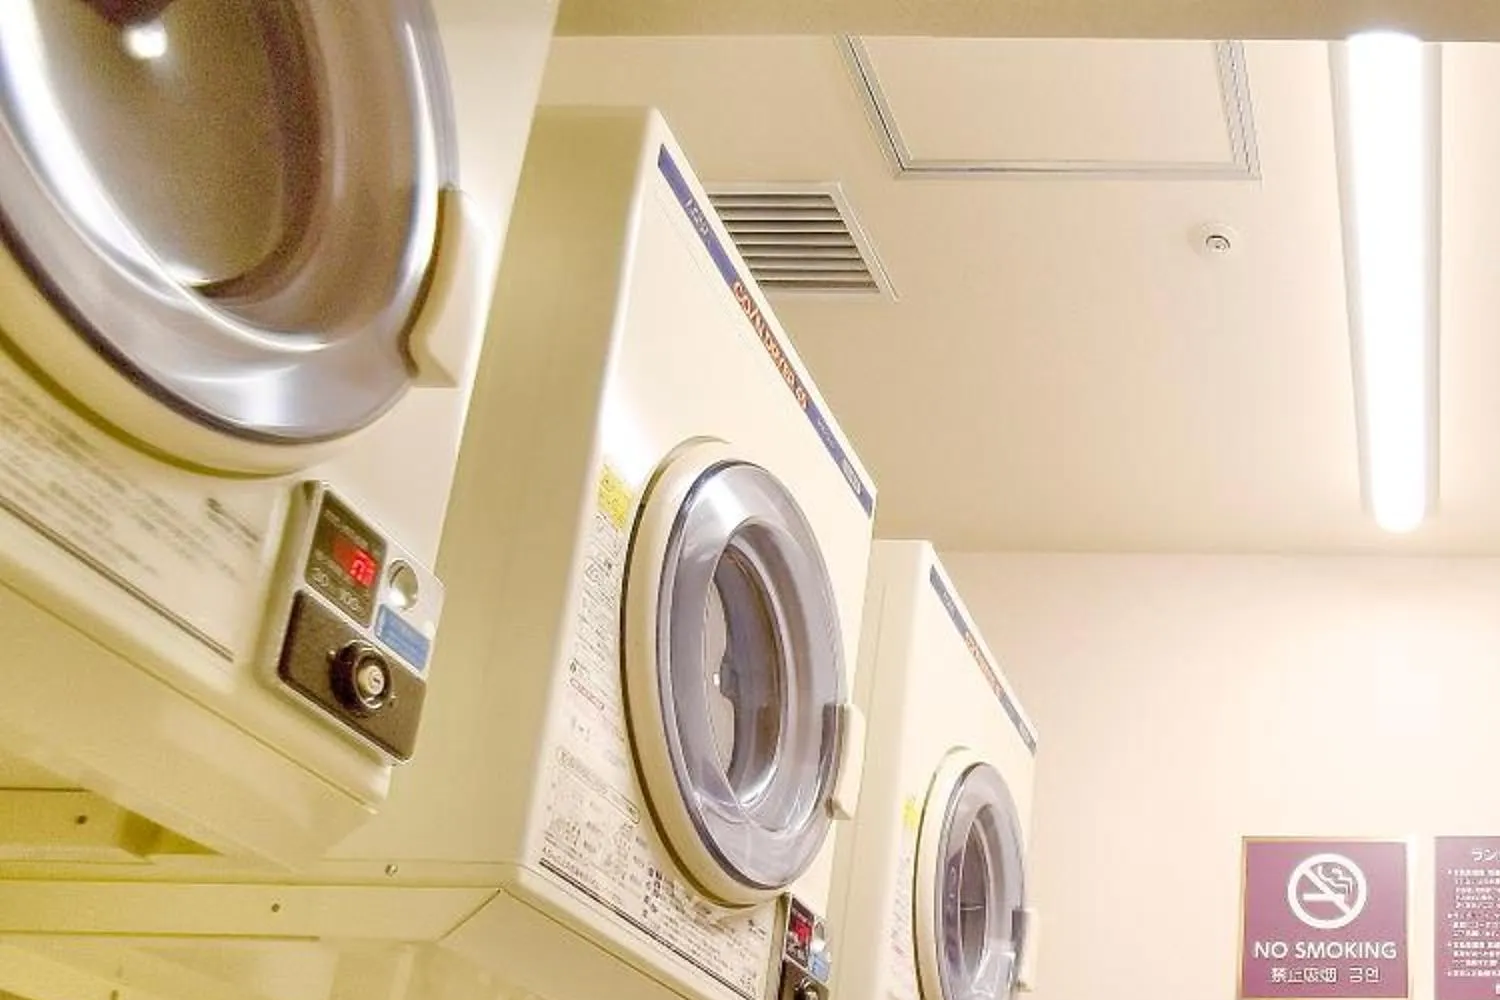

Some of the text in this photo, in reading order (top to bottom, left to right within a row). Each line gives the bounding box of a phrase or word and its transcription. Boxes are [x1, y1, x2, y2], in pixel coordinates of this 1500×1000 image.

[1255, 941, 1397, 959] NO SMOKING
[1350, 967, 1379, 983] 금연
